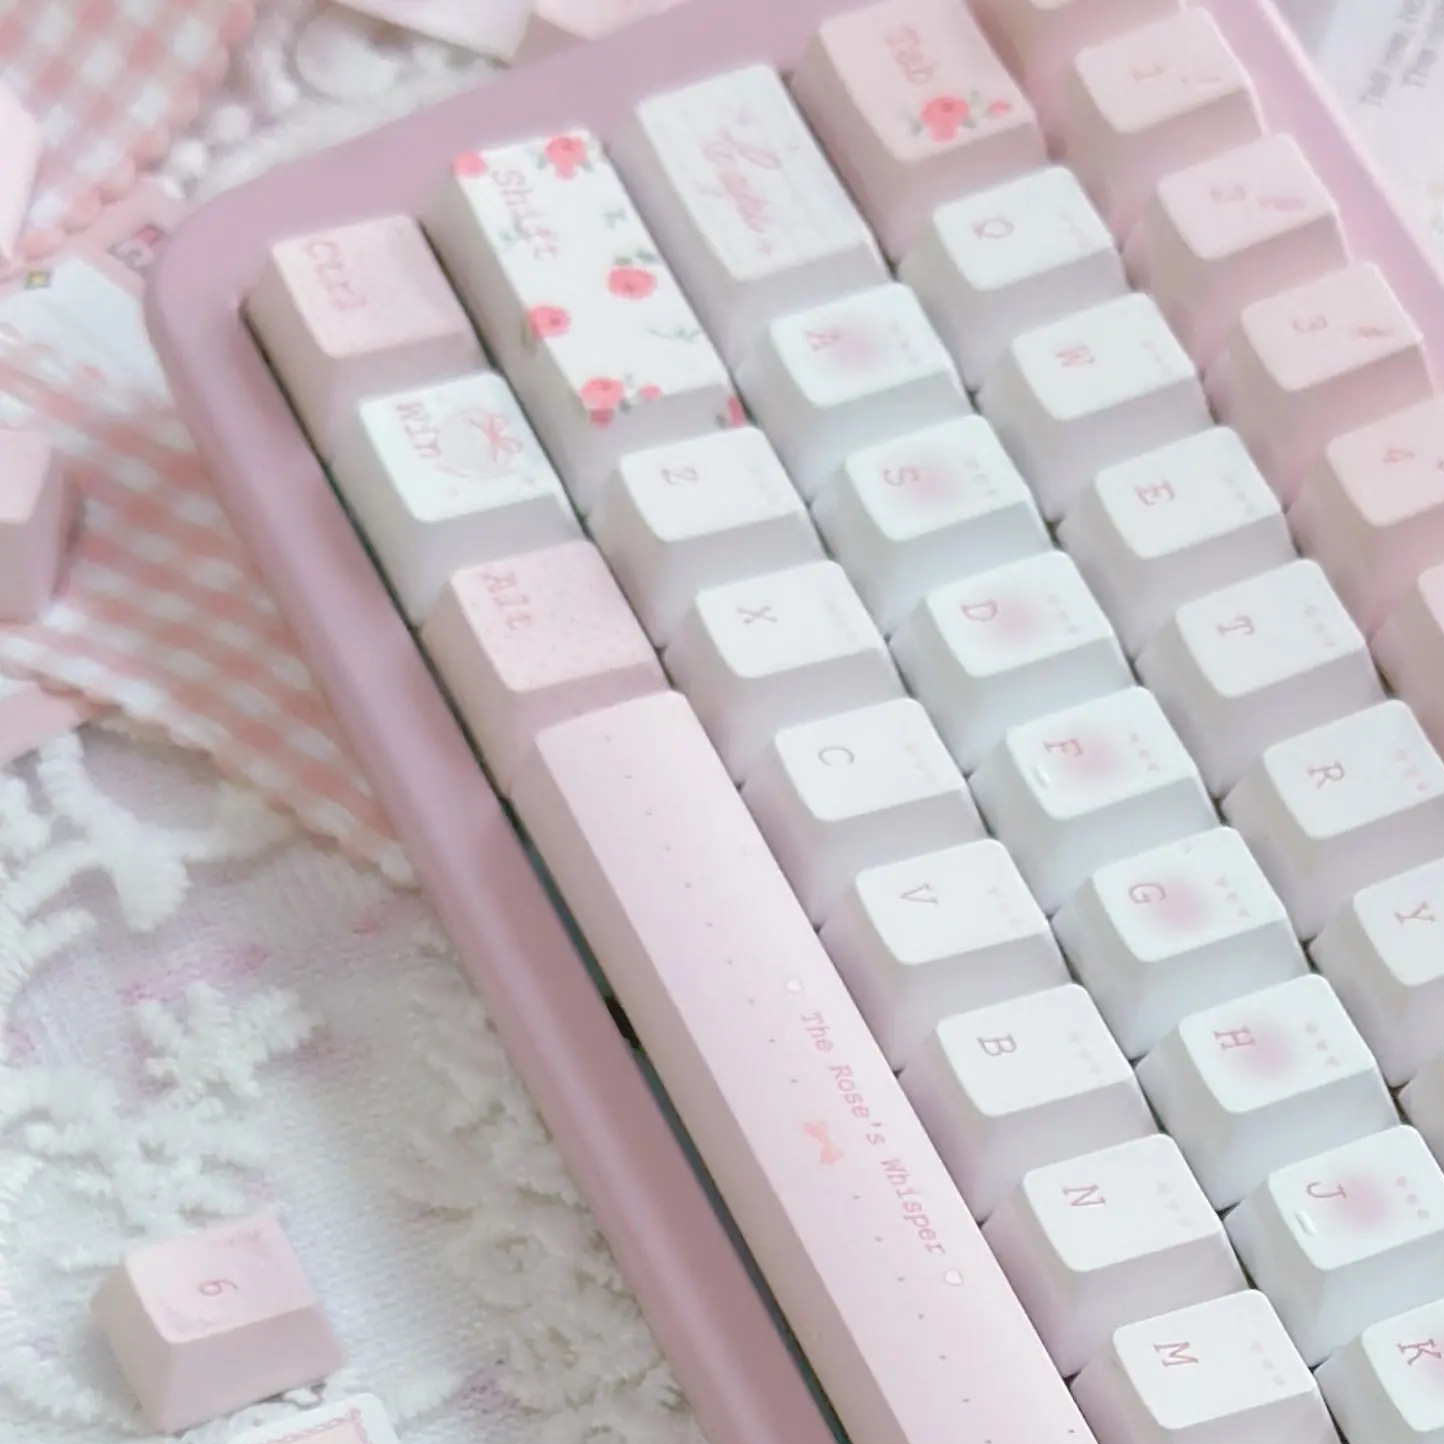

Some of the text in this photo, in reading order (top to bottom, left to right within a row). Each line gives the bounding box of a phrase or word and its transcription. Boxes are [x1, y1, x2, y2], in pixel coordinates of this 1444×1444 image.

[492, 170, 559, 261] Shift
[306, 238, 367, 311] Ctrl
[395, 402, 441, 459] Win
[660, 466, 699, 485] Z
[883, 467, 921, 486] S
[1134, 481, 1175, 505] E
[481, 572, 531, 631] Alt
[961, 600, 998, 621] D
[737, 604, 778, 625] X
[1215, 616, 1255, 638] T
[818, 746, 855, 766] C
[1044, 738, 1083, 757] F
[1307, 761, 1345, 788] R
[899, 883, 938, 906] V
[1128, 882, 1167, 904] G
[1394, 902, 1436, 925] Y
[977, 1032, 1017, 1056] B
[1214, 1026, 1255, 1051] H
[801, 1012, 947, 1257] The Rose's Whisper
[1062, 1184, 1106, 1208] N
[1306, 1181, 1347, 1201] J
[198, 1279, 240, 1298] 6
[1152, 1341, 1199, 1368] M
[1397, 1338, 1442, 1366] K
